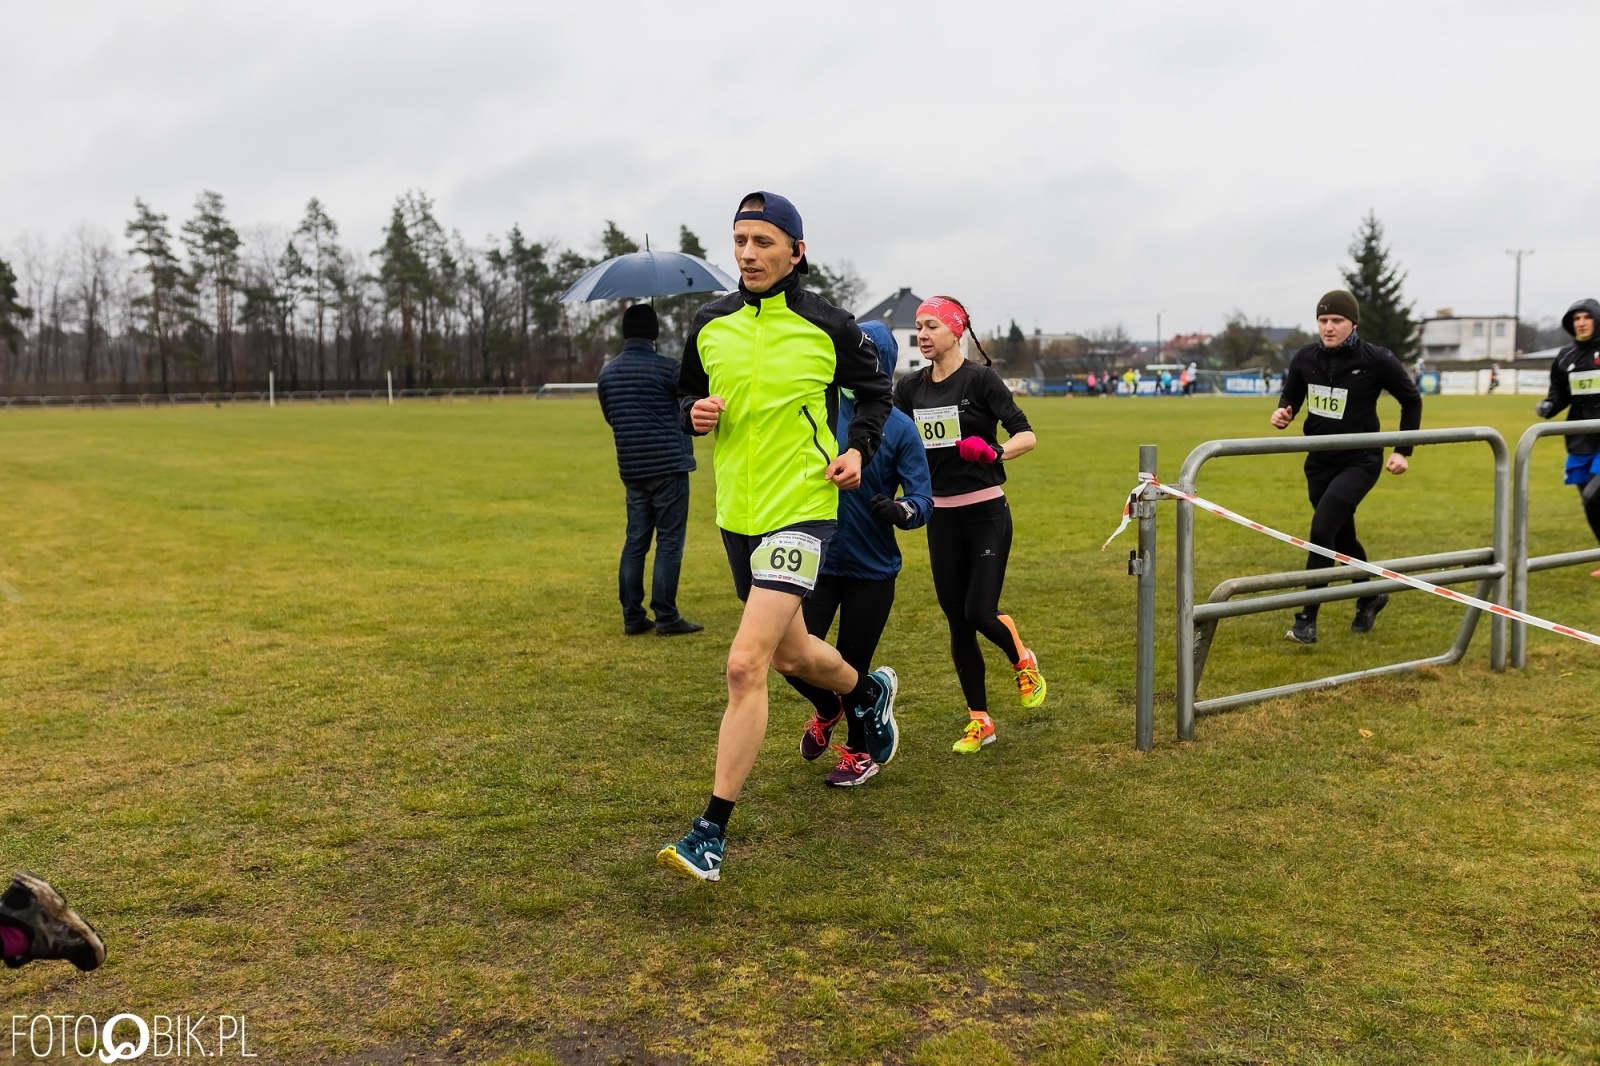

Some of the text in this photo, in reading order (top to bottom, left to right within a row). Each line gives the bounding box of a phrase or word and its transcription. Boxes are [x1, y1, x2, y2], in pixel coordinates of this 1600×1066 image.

[1578, 379, 1593, 390] 67
[1313, 395, 1339, 412] 116
[923, 421, 946, 440] 80
[770, 547, 803, 572] 69
